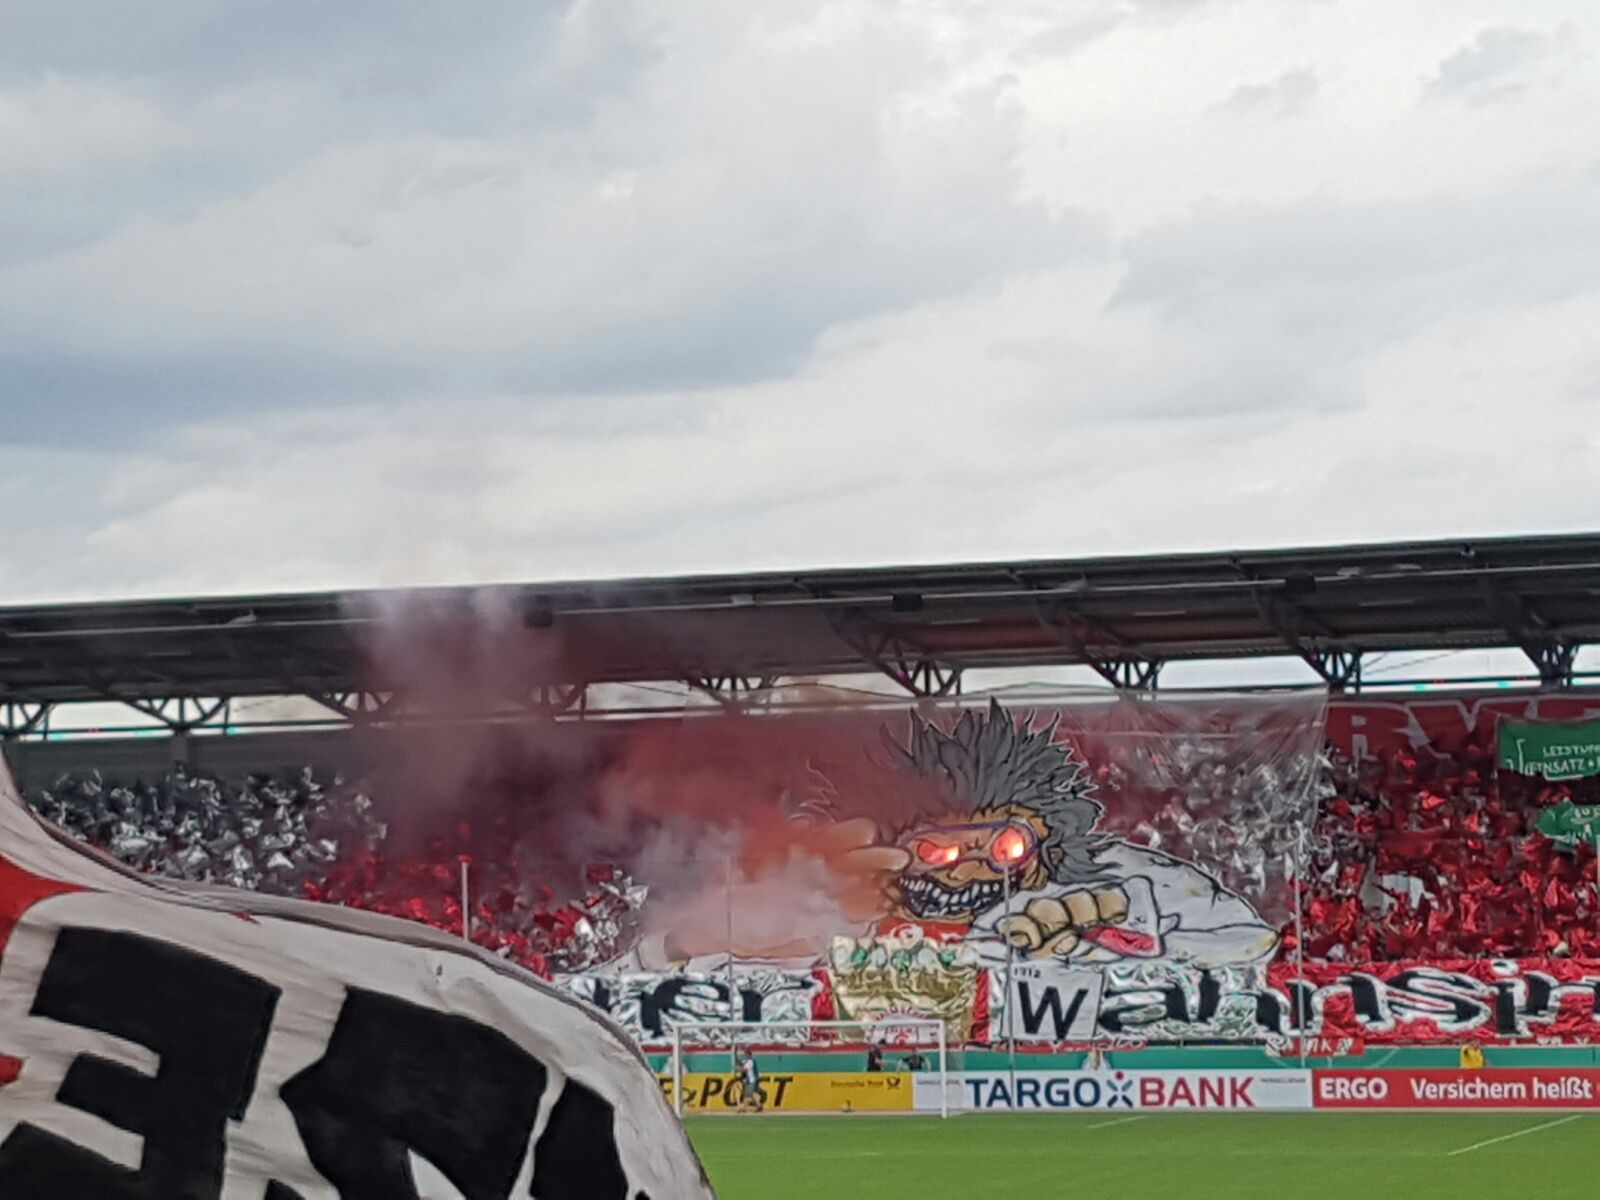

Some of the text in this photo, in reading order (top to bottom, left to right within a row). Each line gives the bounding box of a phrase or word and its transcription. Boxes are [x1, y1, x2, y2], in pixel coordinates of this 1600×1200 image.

[1320, 1076, 1592, 1099] ERGO Versichern heißt
